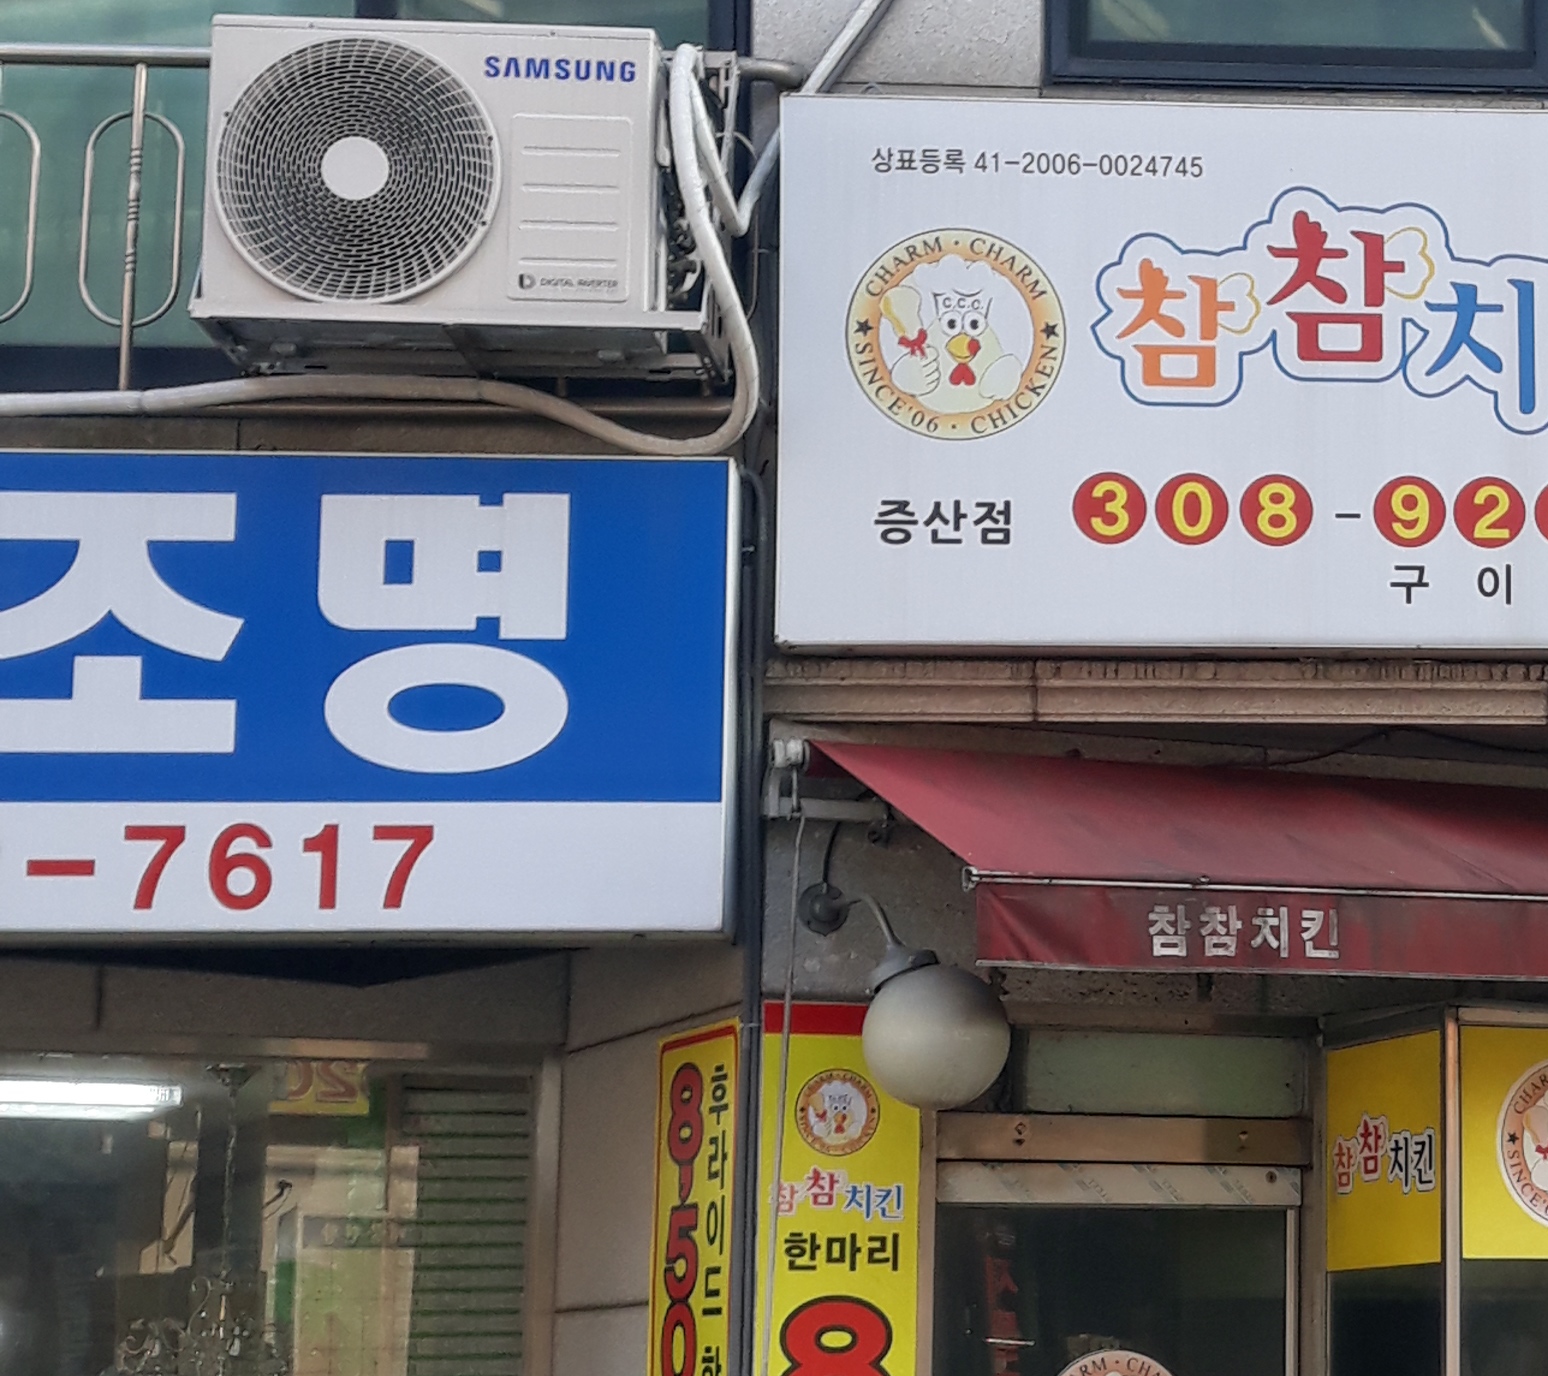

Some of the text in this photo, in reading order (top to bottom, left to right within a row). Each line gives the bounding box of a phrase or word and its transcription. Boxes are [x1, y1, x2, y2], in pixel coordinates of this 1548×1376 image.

[484, 54, 637, 83] SAMSUNG
[870, 146, 1205, 180] 상표등록 41-2006-0024745
[864, 235, 1048, 301] CHARM CHARM
[970, 344, 1059, 435] CHICKEN
[873, 497, 1013, 546] 증산점
[0, 491, 571, 775] 조명
[1146, 904, 1342, 960] 참참치킨
[784, 1230, 900, 1272] 한마리
